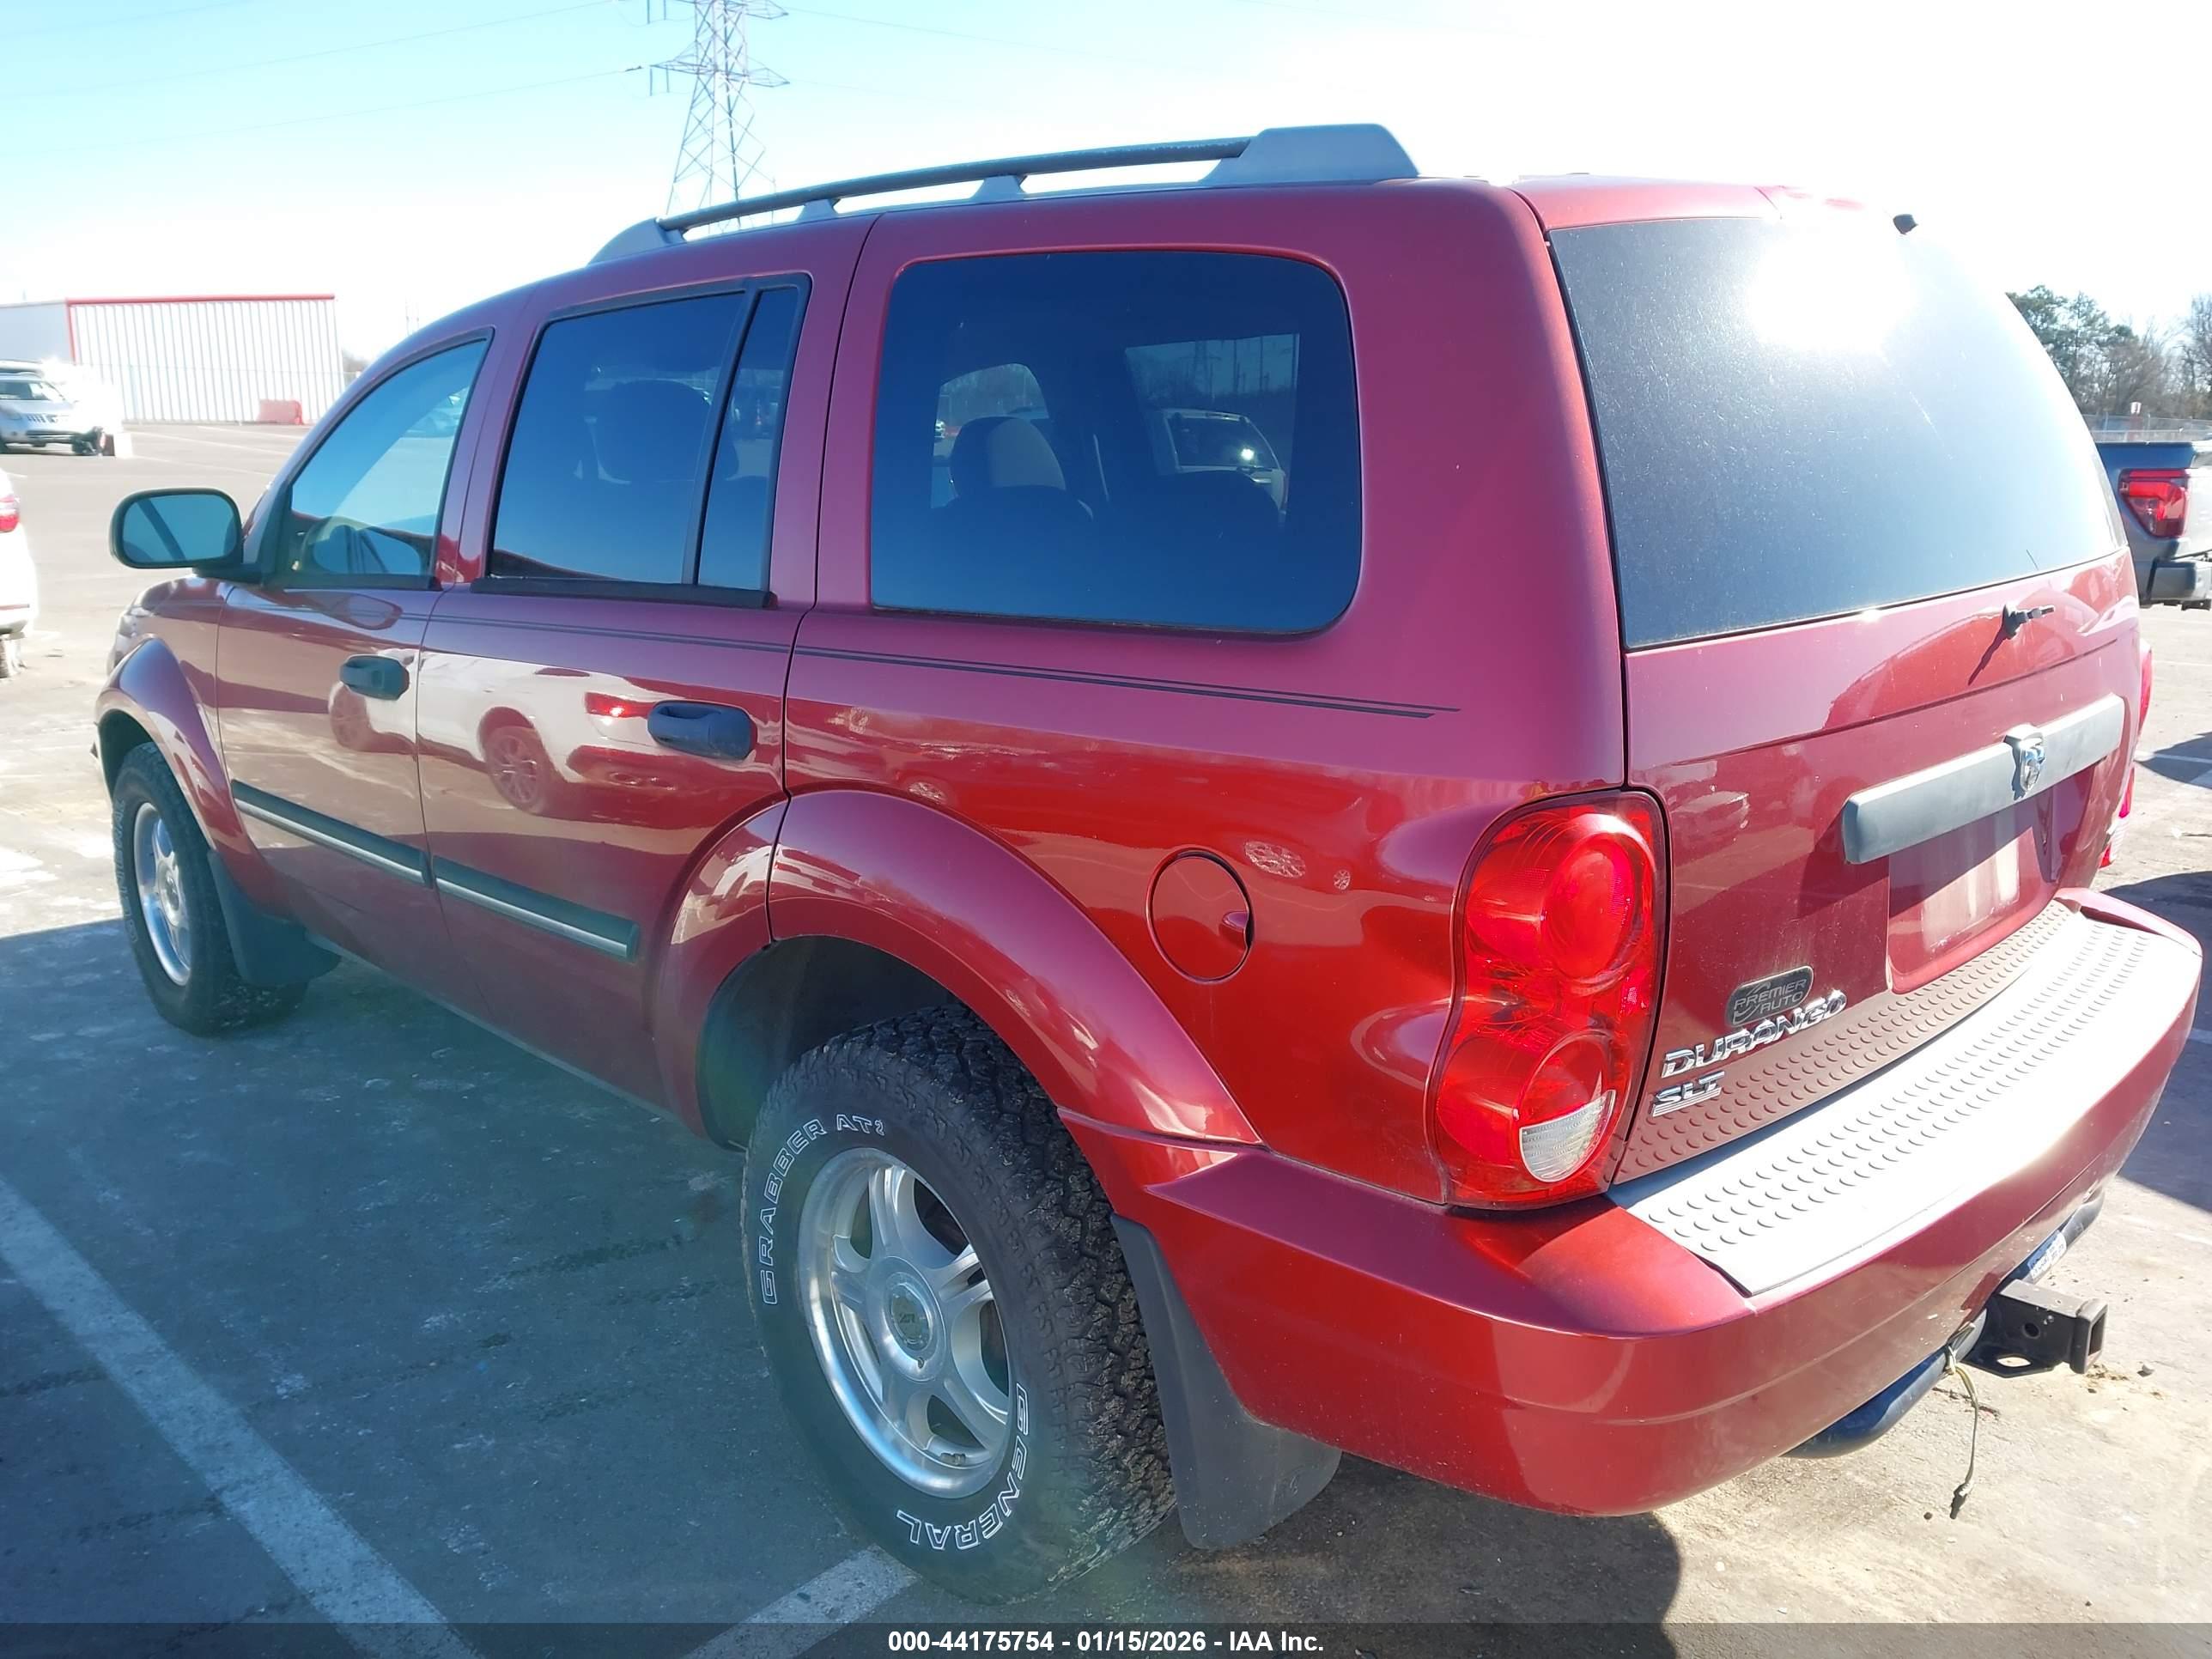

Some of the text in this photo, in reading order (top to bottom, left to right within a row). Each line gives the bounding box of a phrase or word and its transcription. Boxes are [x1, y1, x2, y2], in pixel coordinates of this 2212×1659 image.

[1734, 979, 1807, 1011] PREMIER
[1760, 992, 1804, 1014] AUTO
[1661, 988, 1847, 1078] DURANGO
[1655, 1071, 1725, 1103] SLT
[759, 1119, 827, 1304] GRABBER
[896, 1382, 1029, 1551] GENERAL
